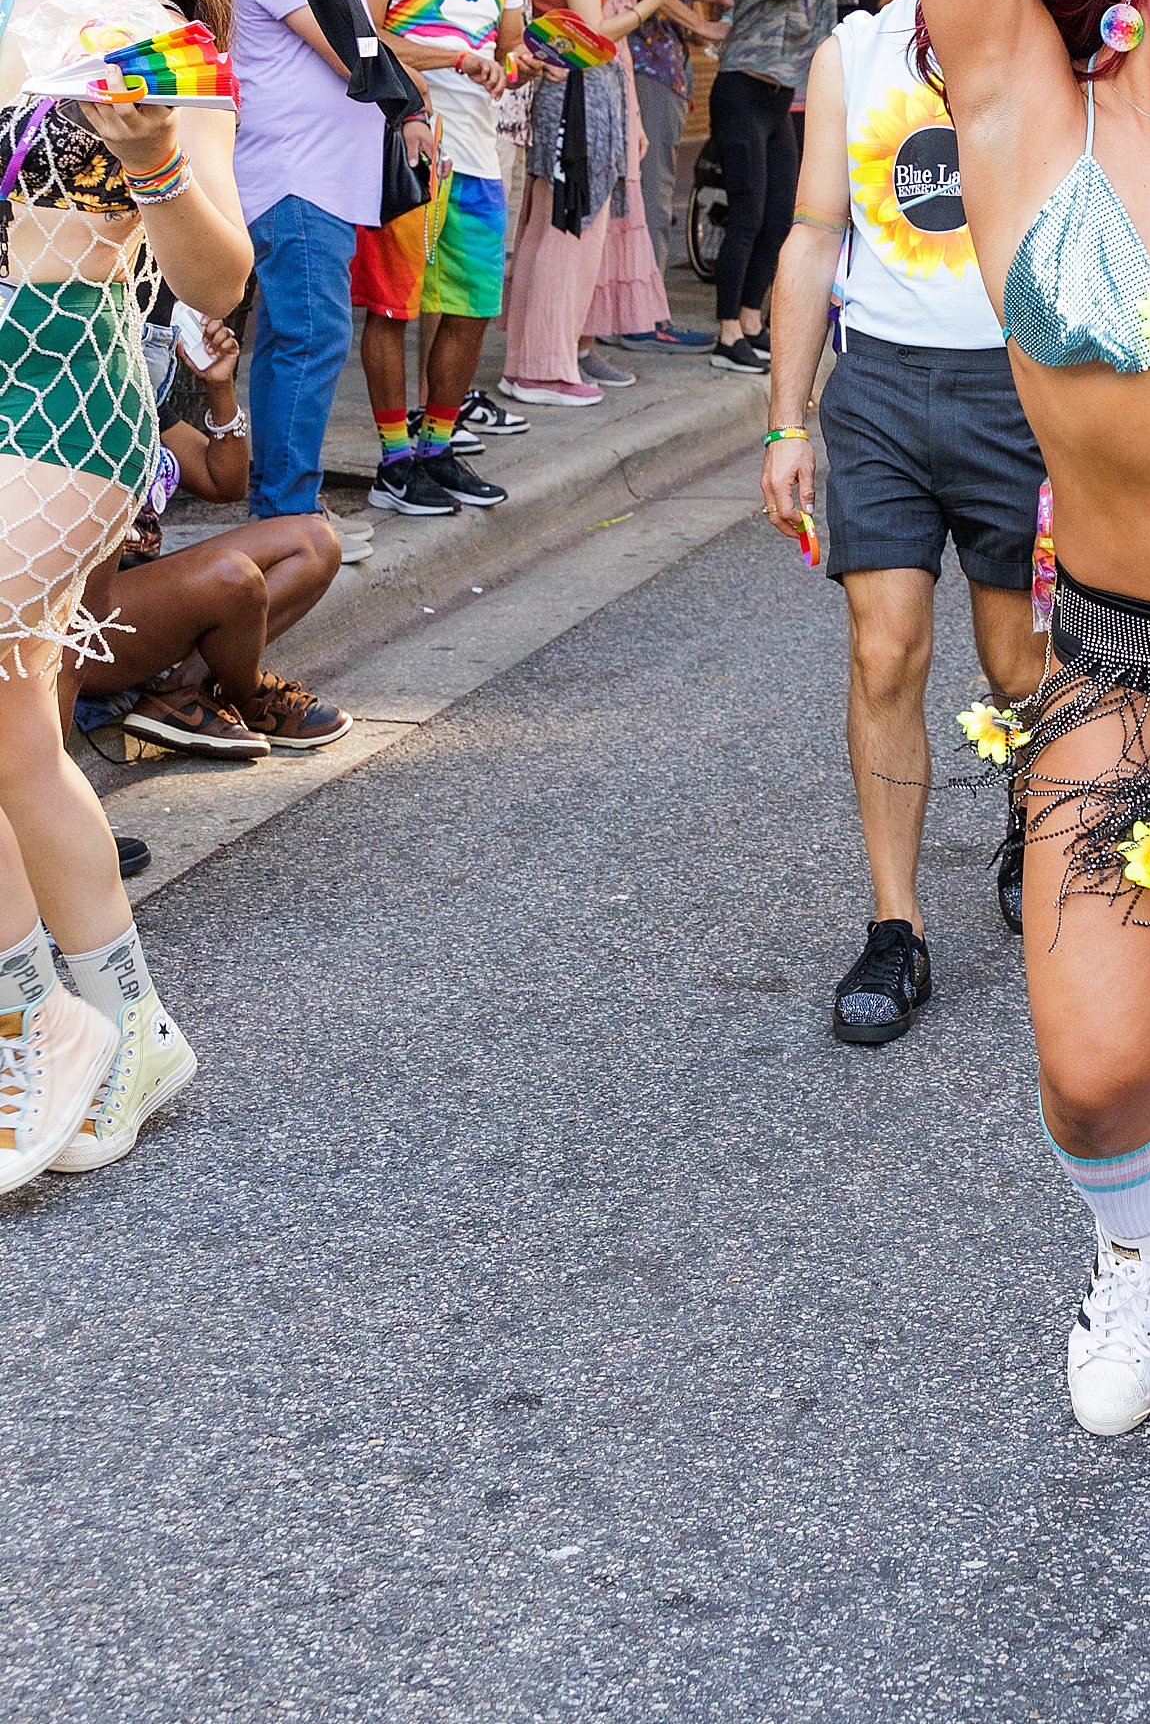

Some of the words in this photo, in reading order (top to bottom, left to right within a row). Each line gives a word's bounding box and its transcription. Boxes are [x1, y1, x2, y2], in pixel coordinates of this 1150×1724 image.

[895, 163, 933, 187] Blue
[936, 163, 961, 185] La
[13, 965, 45, 1004] PLA
